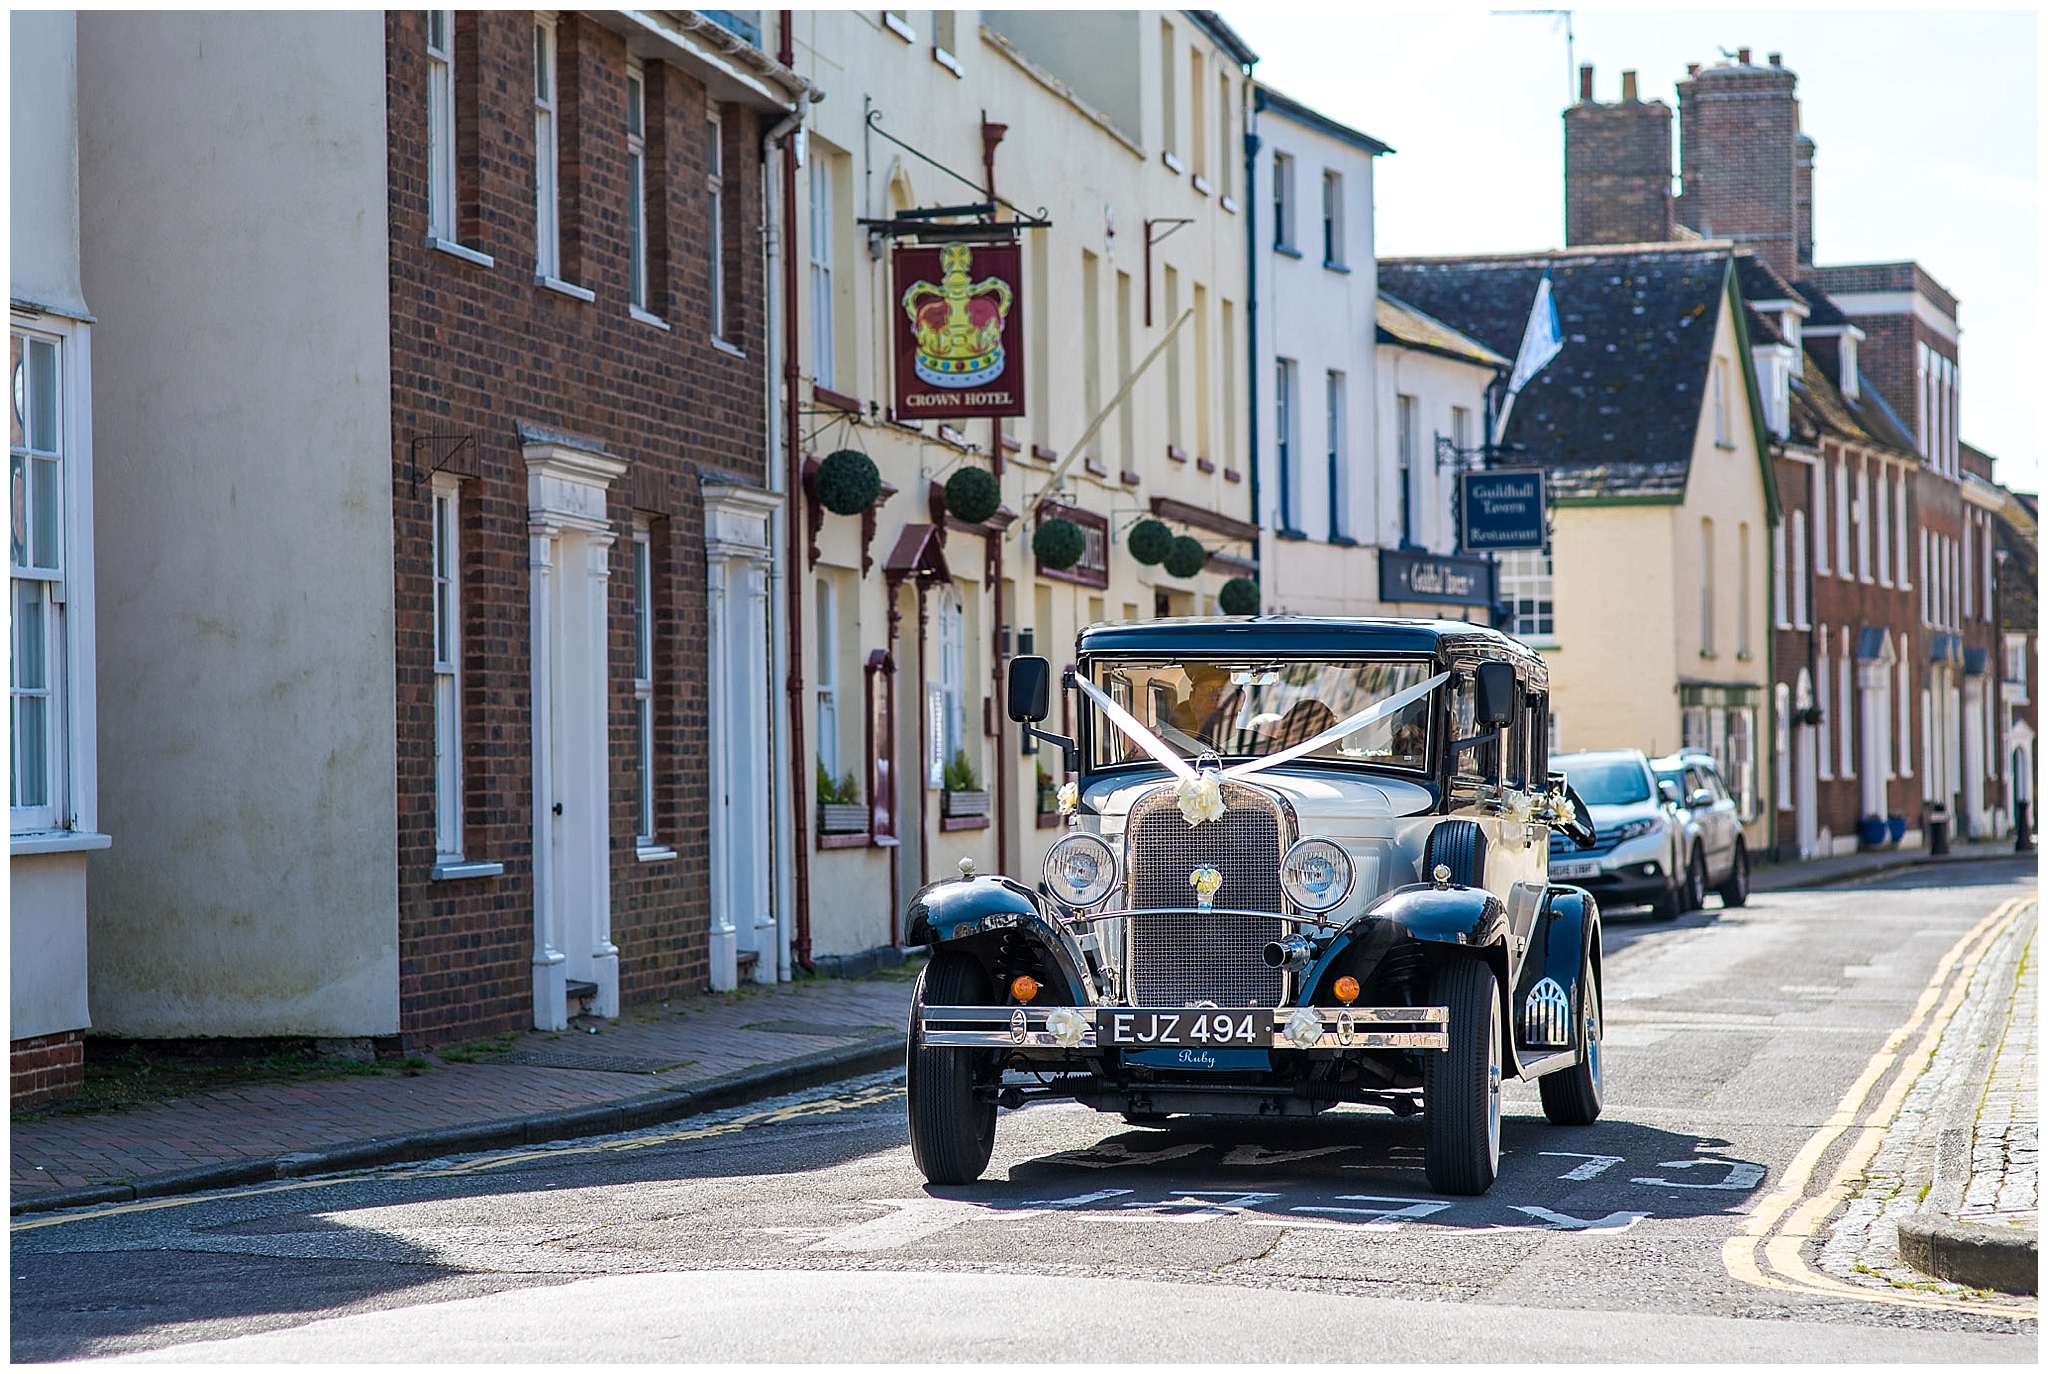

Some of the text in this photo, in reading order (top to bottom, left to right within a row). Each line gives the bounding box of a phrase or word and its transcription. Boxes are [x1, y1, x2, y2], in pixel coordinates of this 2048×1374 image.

[906, 391, 1013, 407] CROWN HOTEL
[1472, 483, 1533, 499] Guildhall
[1483, 502, 1526, 514] Tavern
[1470, 529, 1538, 542] Restaurant
[1114, 1014, 1256, 1043] EJZ 494
[1178, 1049, 1216, 1068] Ruby
